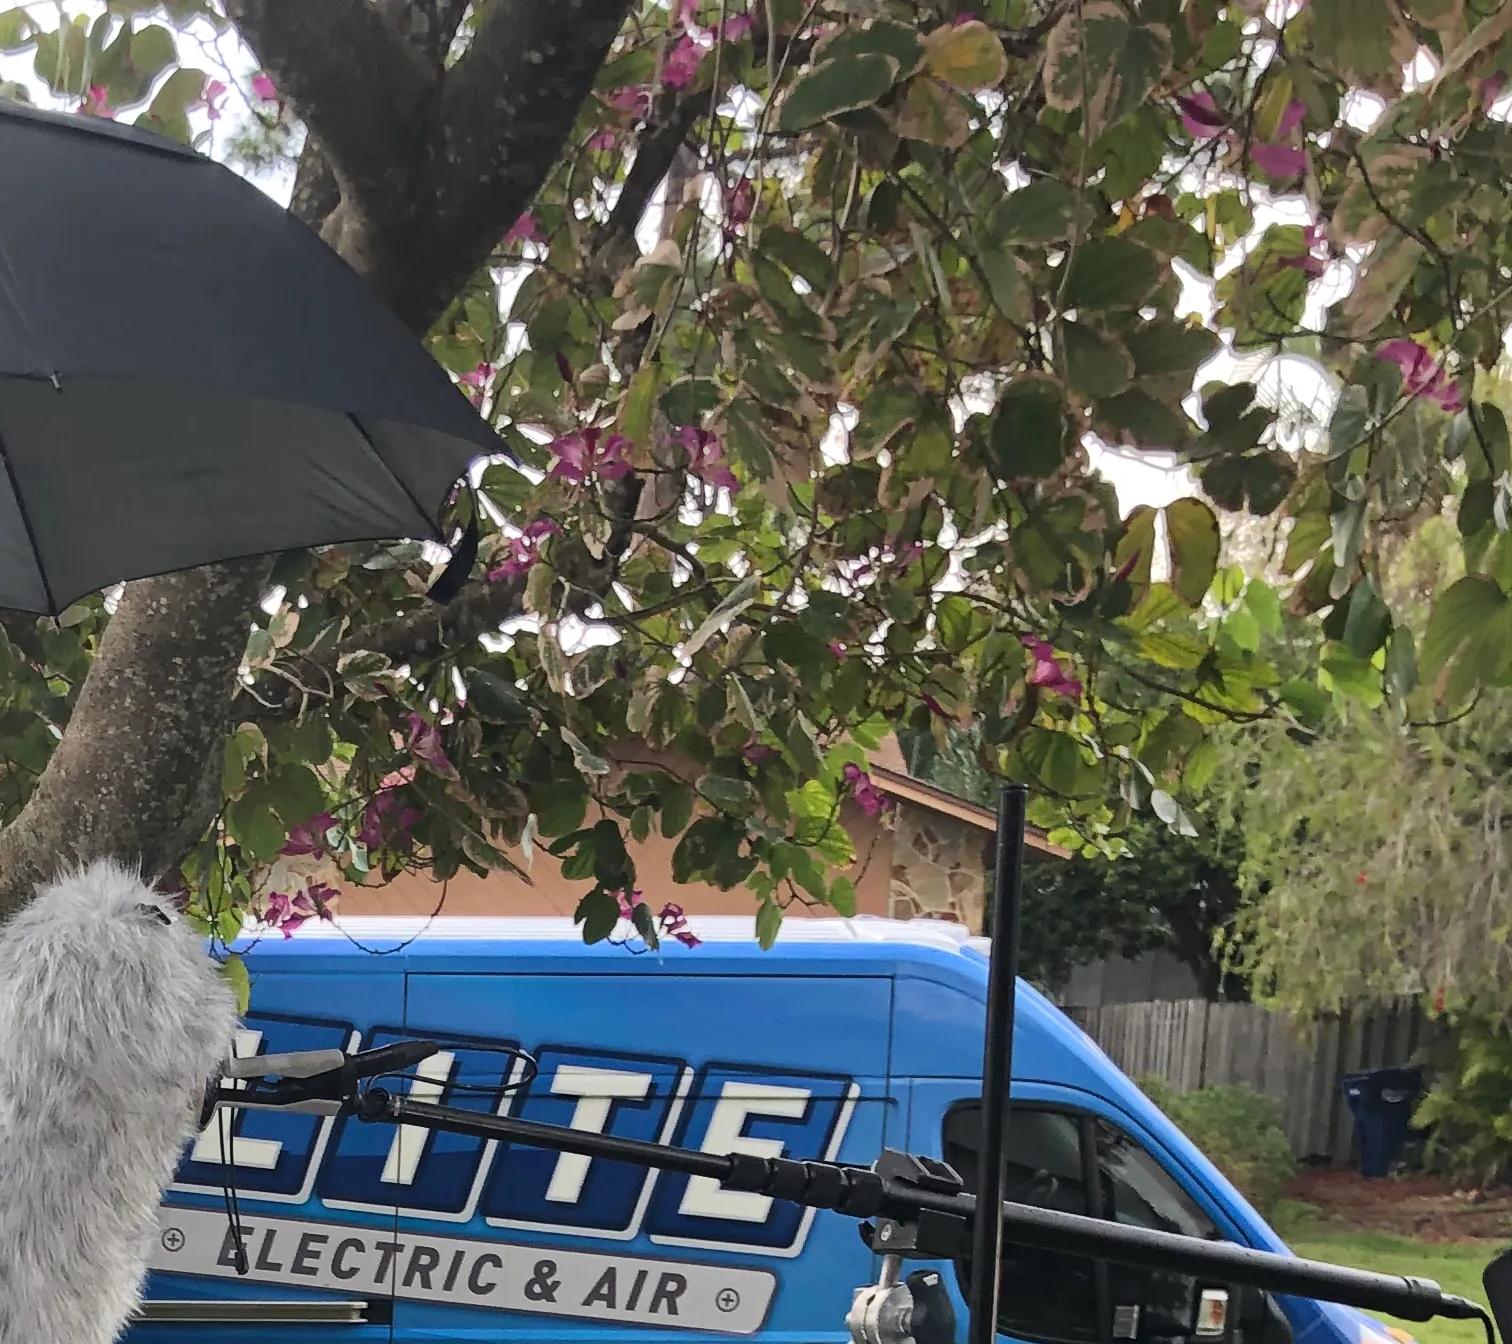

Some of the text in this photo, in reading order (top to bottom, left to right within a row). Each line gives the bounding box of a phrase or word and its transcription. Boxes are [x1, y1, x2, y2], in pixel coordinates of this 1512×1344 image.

[190, 1028, 812, 1222] LITE
[216, 1224, 688, 1316] ELECTRIC & AIR
